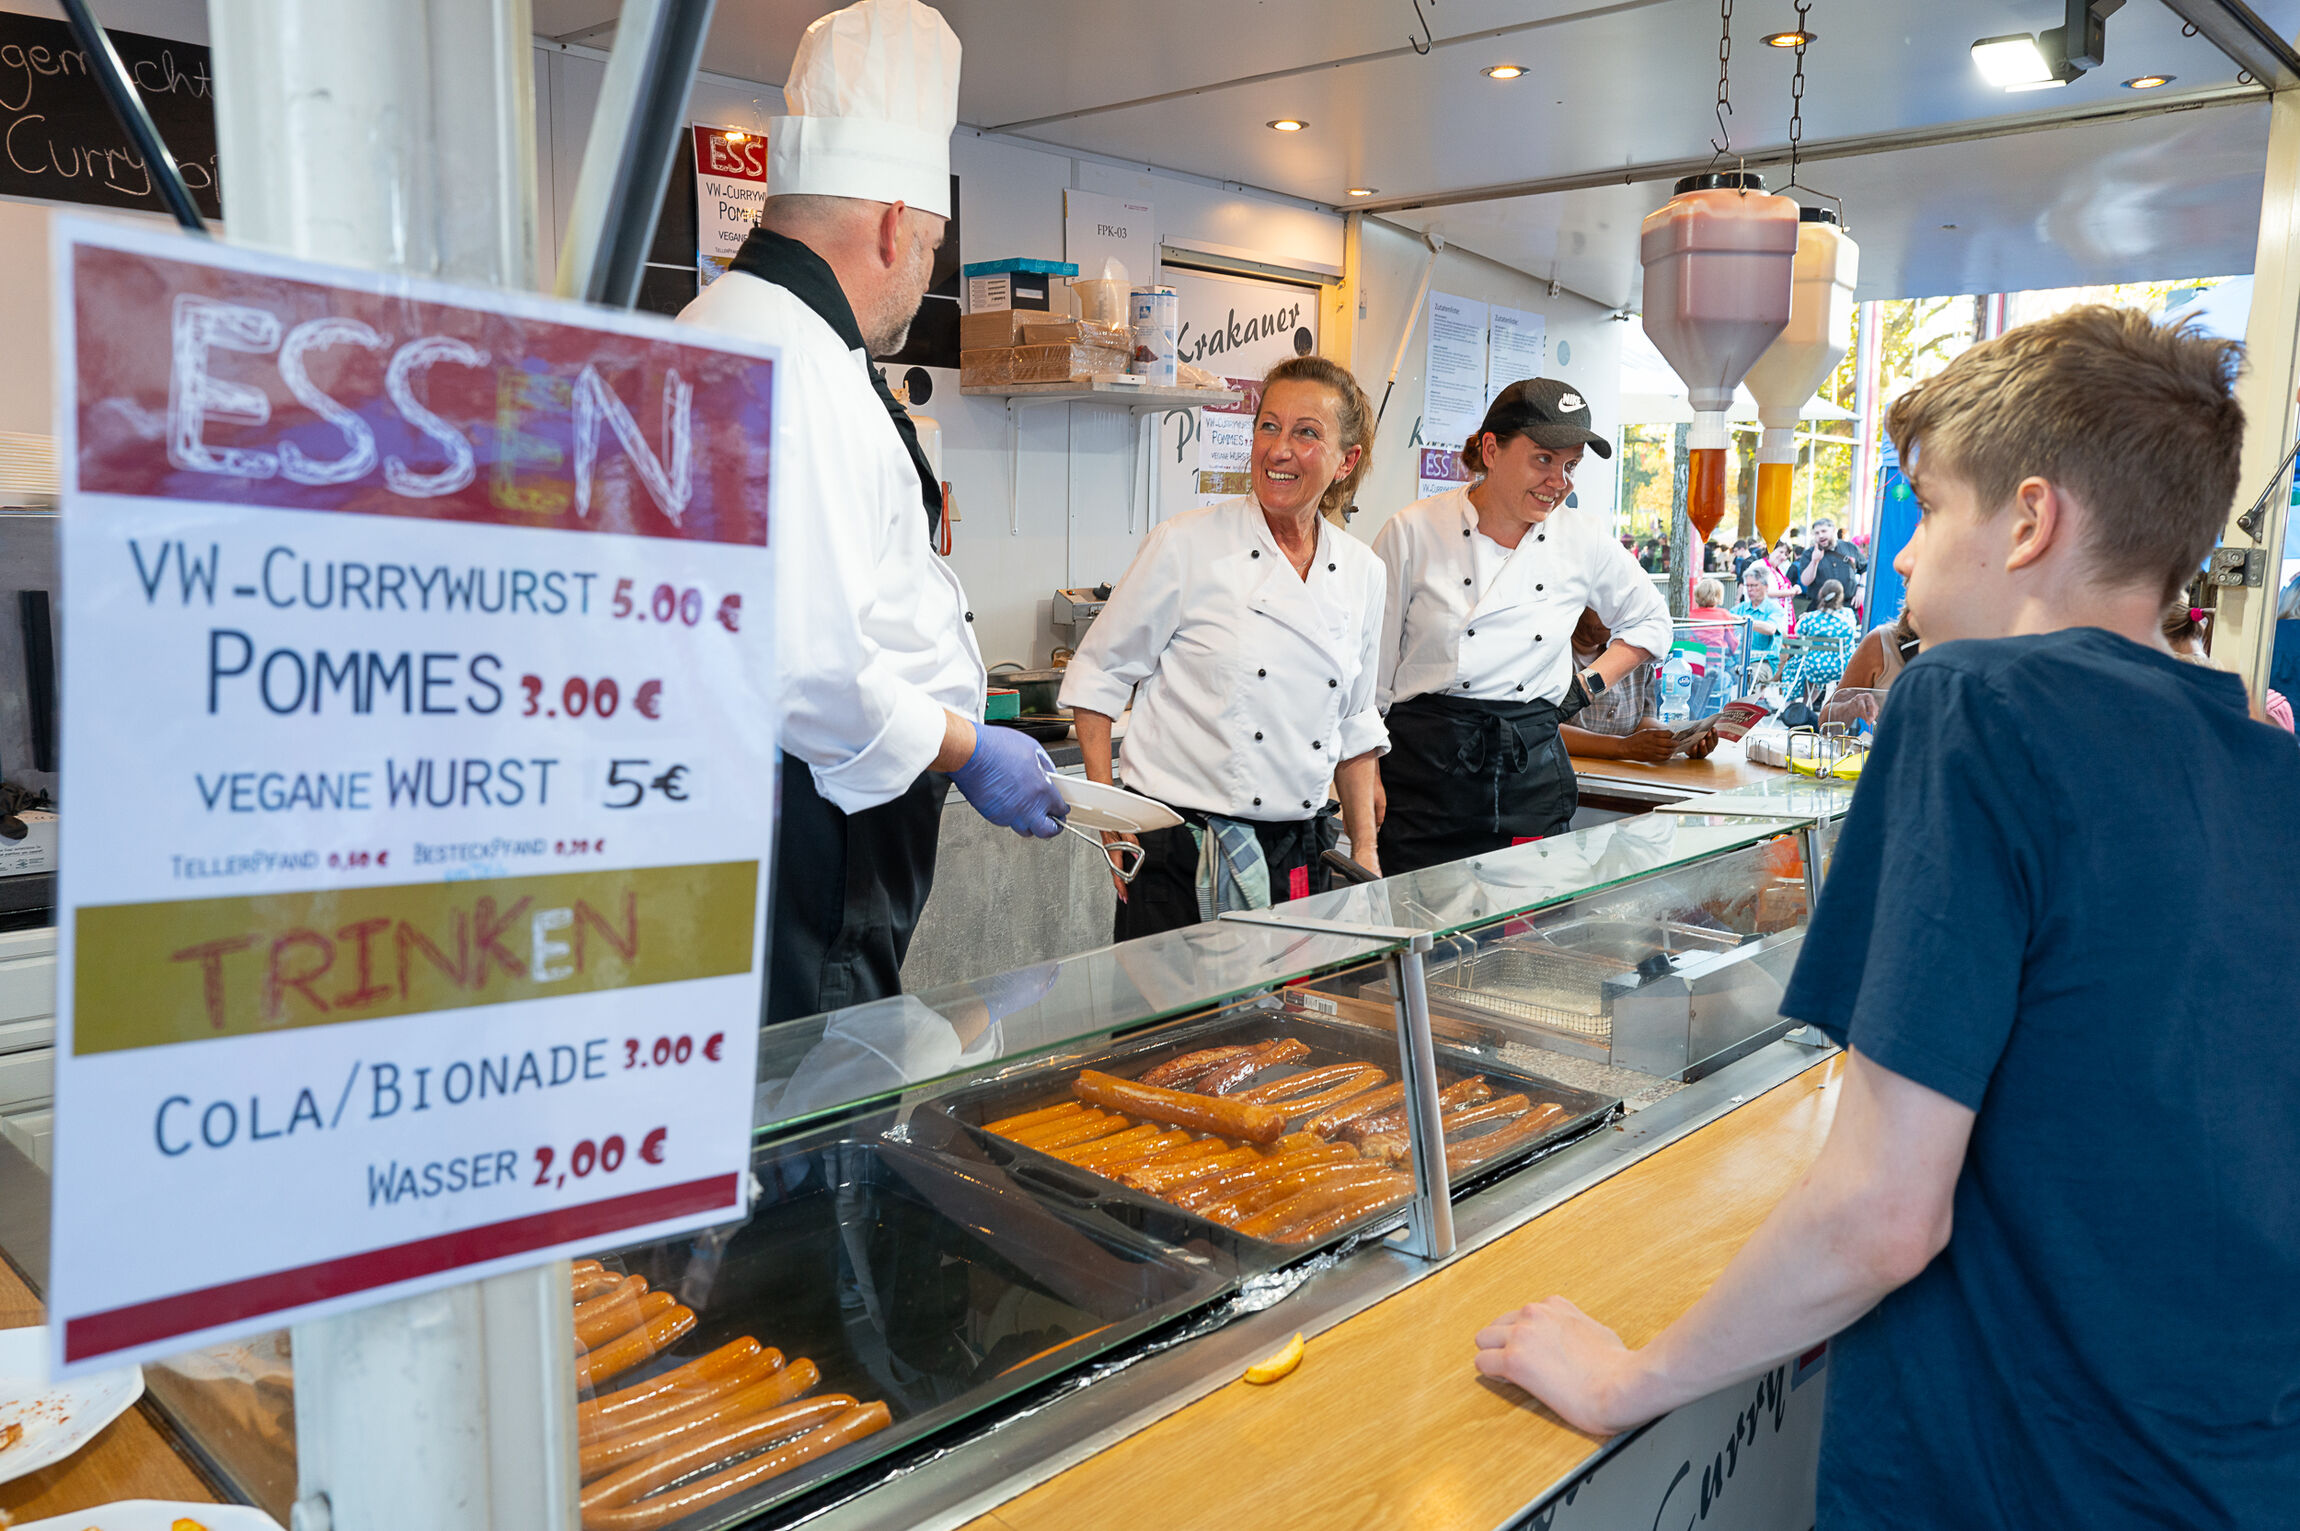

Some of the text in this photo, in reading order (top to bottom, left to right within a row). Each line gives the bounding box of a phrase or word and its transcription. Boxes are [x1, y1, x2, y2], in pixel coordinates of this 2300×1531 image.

[1097, 224, 1127, 239] FPK-03
[167, 293, 693, 528] ESSEN
[1562, 392, 1581, 405] NIKE
[129, 538, 742, 633] VW-CURRYWURST 5.00 €
[206, 628, 663, 720] POMMES 3.00 €
[195, 772, 373, 812] VEGANE
[386, 758, 559, 808] WURST
[169, 886, 640, 1030] TRINKEN
[153, 1032, 725, 1158] COLA/BIONADE 3.00 €
[366, 1126, 668, 1208] WASSER 2,00 €
